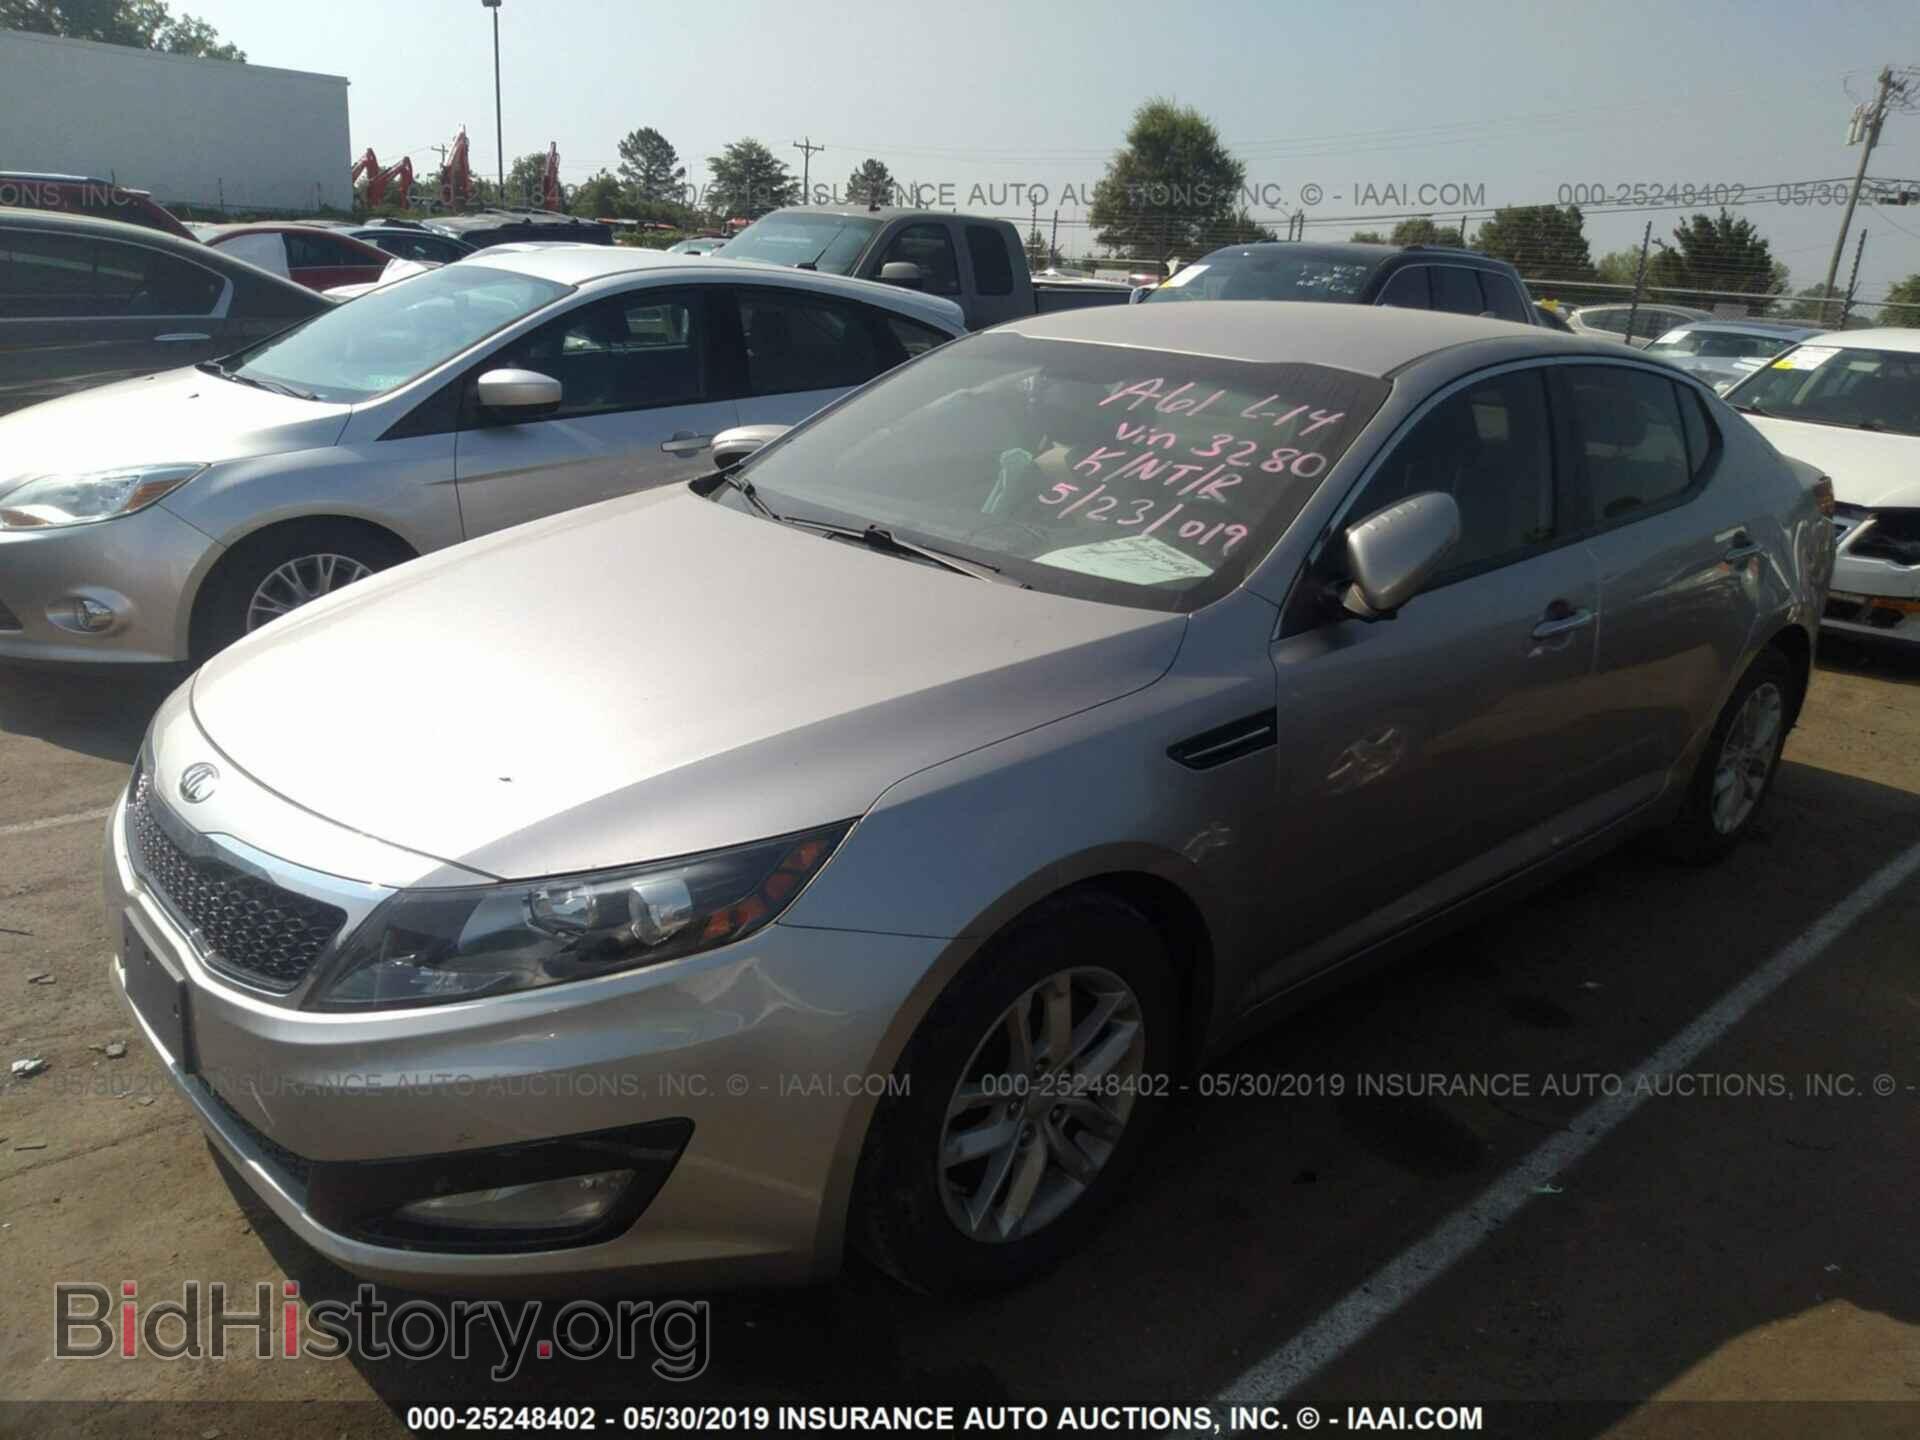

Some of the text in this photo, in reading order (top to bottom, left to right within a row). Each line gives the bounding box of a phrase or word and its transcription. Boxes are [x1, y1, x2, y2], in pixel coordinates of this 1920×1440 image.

[1098, 377, 1225, 417] A61
[1189, 433, 1328, 478] 3280
[1037, 483, 1249, 557] 5/23/019
